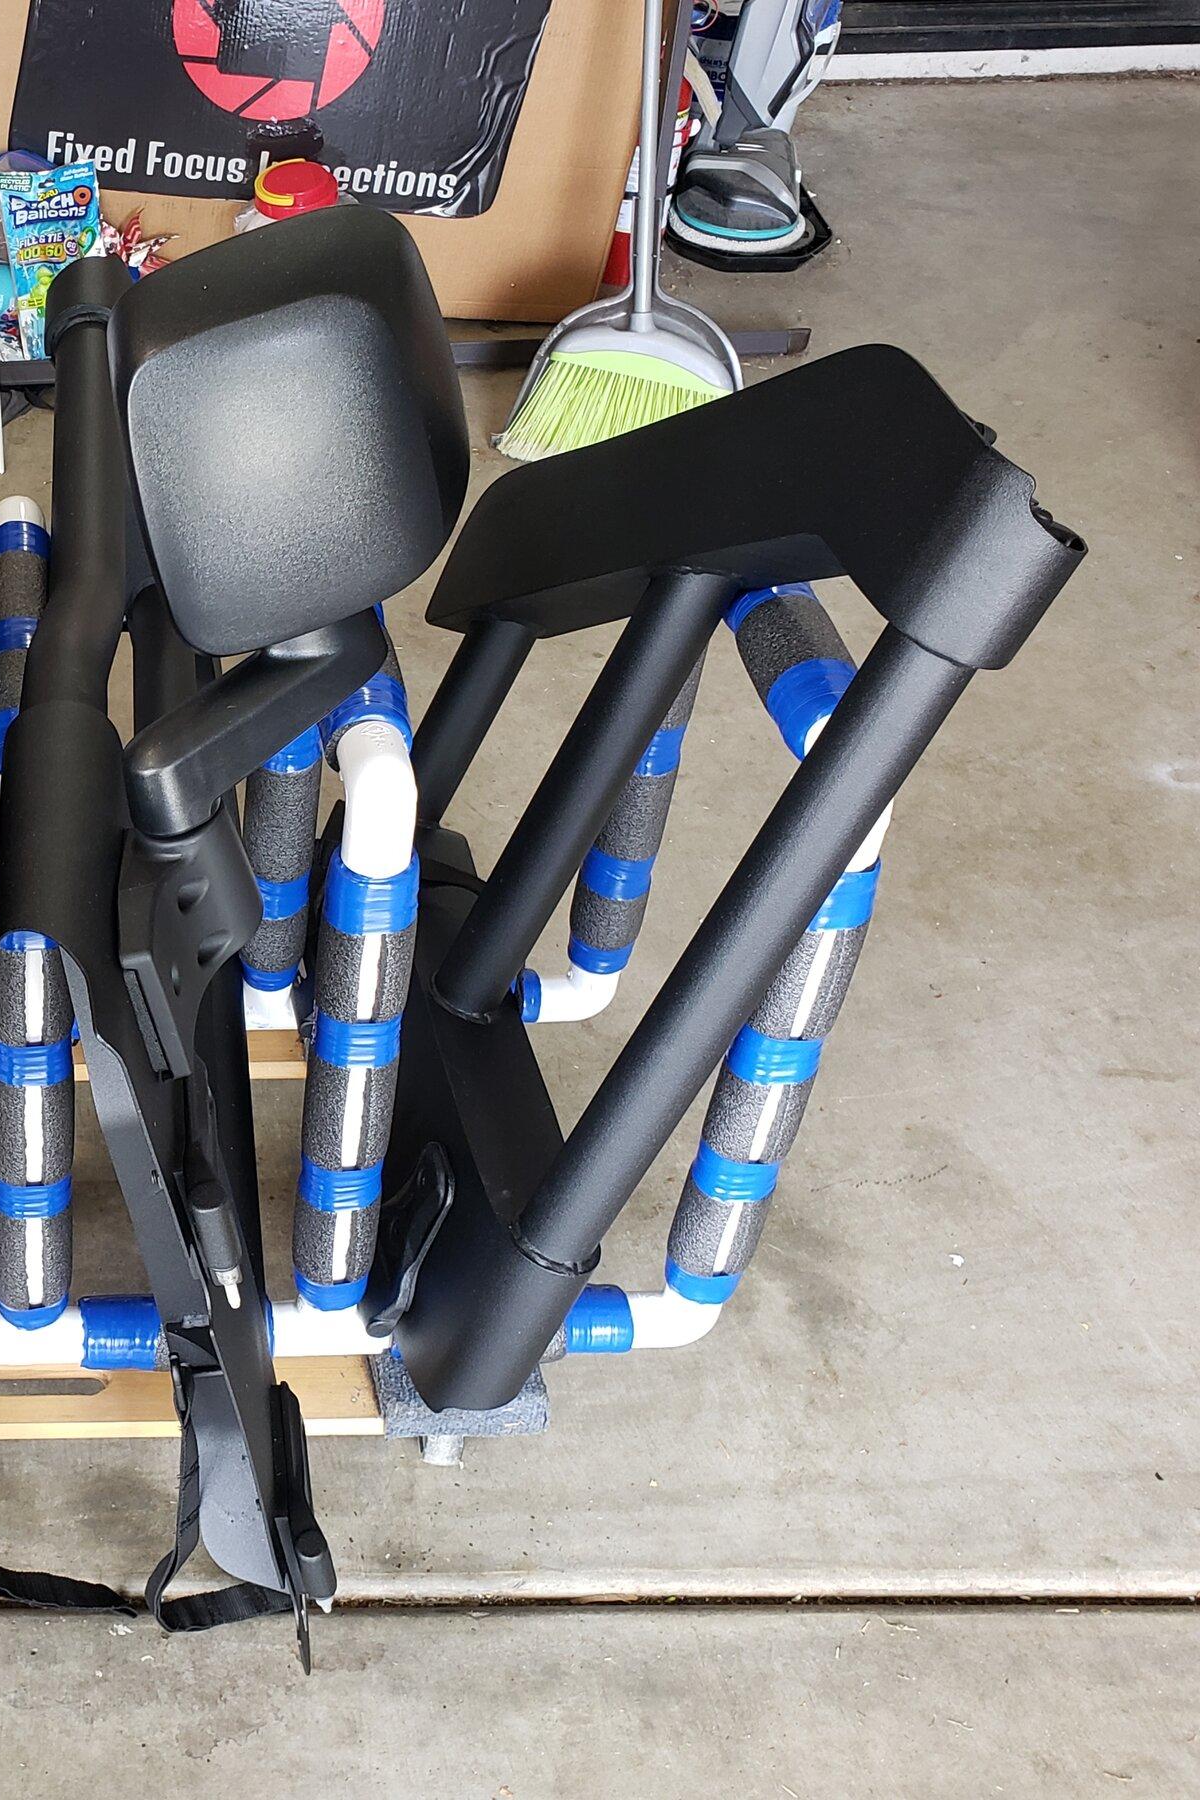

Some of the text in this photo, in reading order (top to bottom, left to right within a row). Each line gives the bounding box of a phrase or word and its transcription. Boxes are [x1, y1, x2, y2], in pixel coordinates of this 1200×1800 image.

[47, 131, 458, 199] Fixed Focus Iections
[0, 184, 31, 192] PLASTIC
[38, 189, 58, 201] ZURU
[15, 206, 87, 226] Balloons
[20, 235, 38, 249] FILL
[47, 232, 63, 243] TIE
